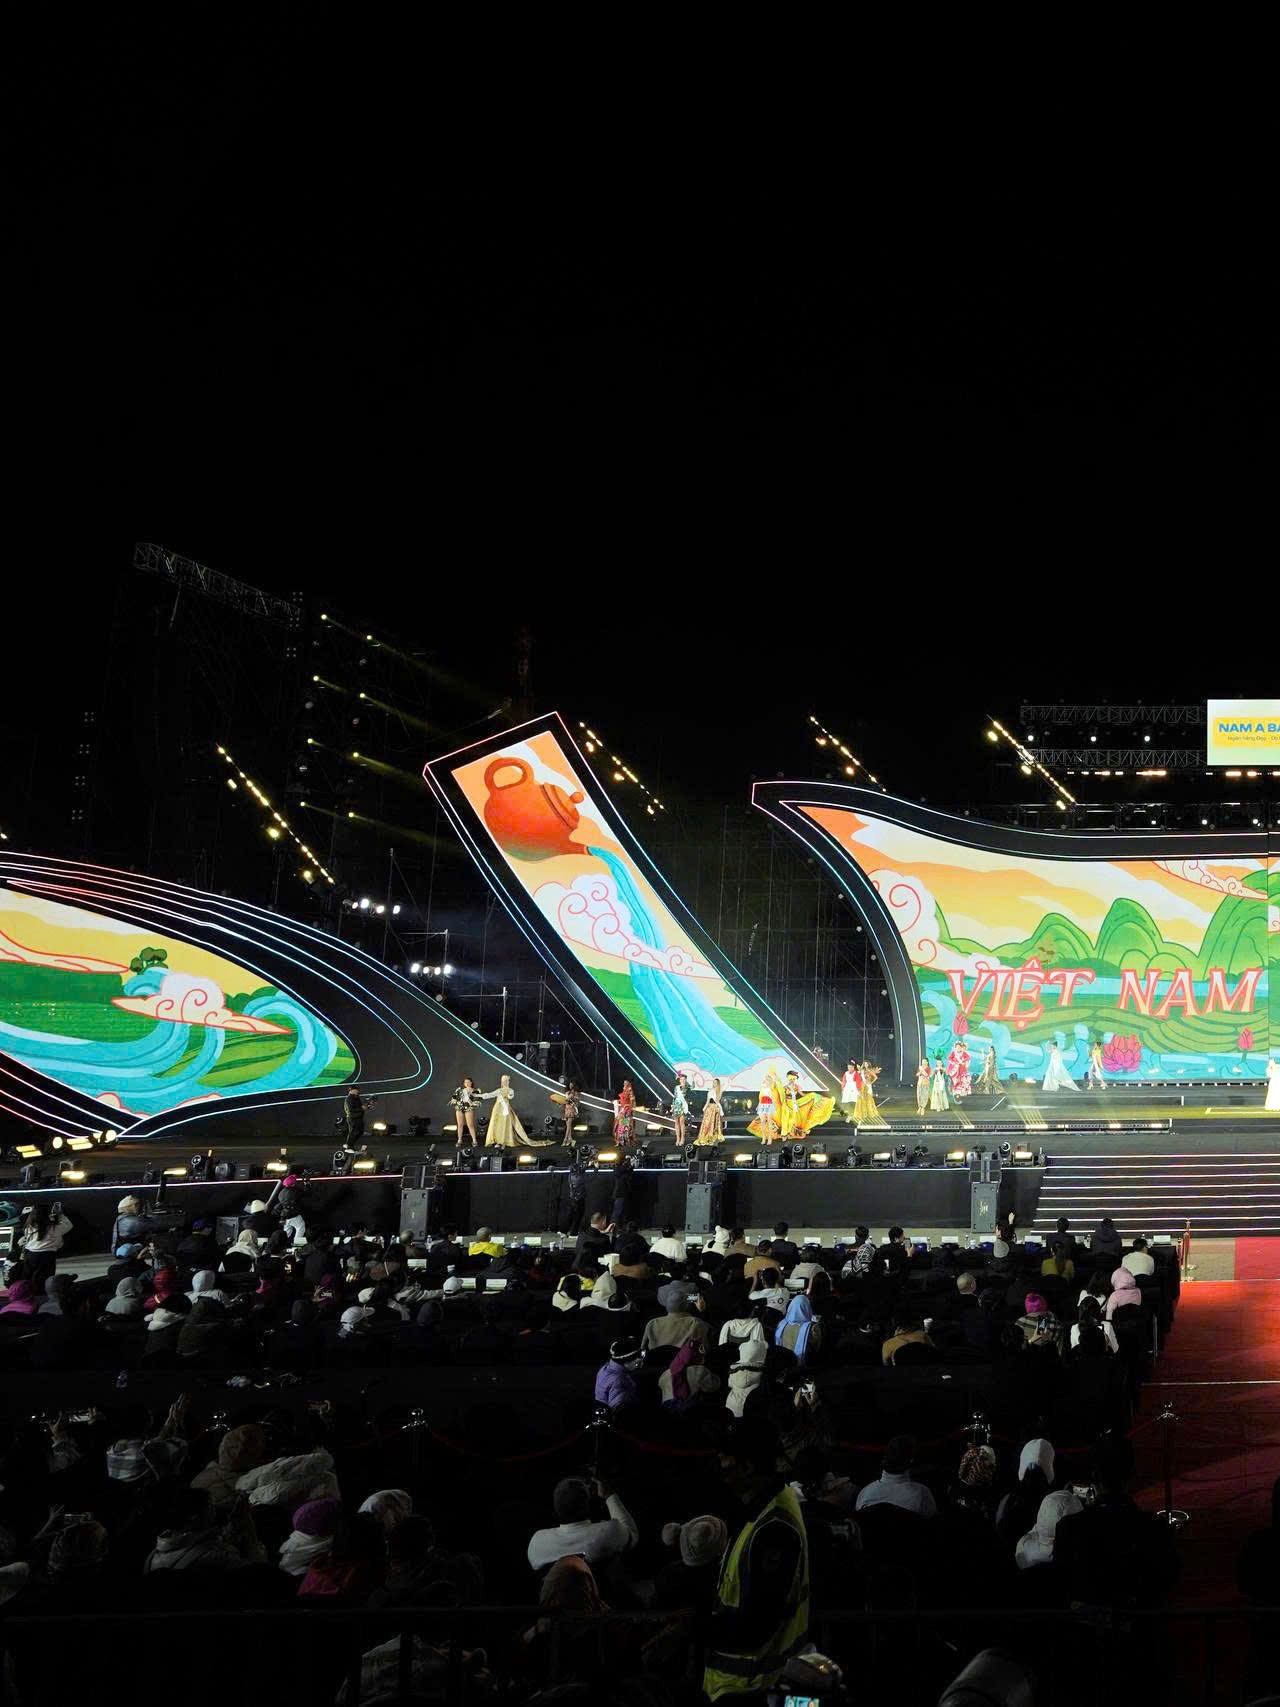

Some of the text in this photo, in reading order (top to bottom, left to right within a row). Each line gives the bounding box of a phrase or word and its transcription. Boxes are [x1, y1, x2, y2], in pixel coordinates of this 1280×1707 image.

[1218, 723, 1252, 733] NAM
[1255, 723, 1265, 733] A
[946, 956, 1095, 1030] VIỆT
[1120, 968, 1263, 1019] NAM
